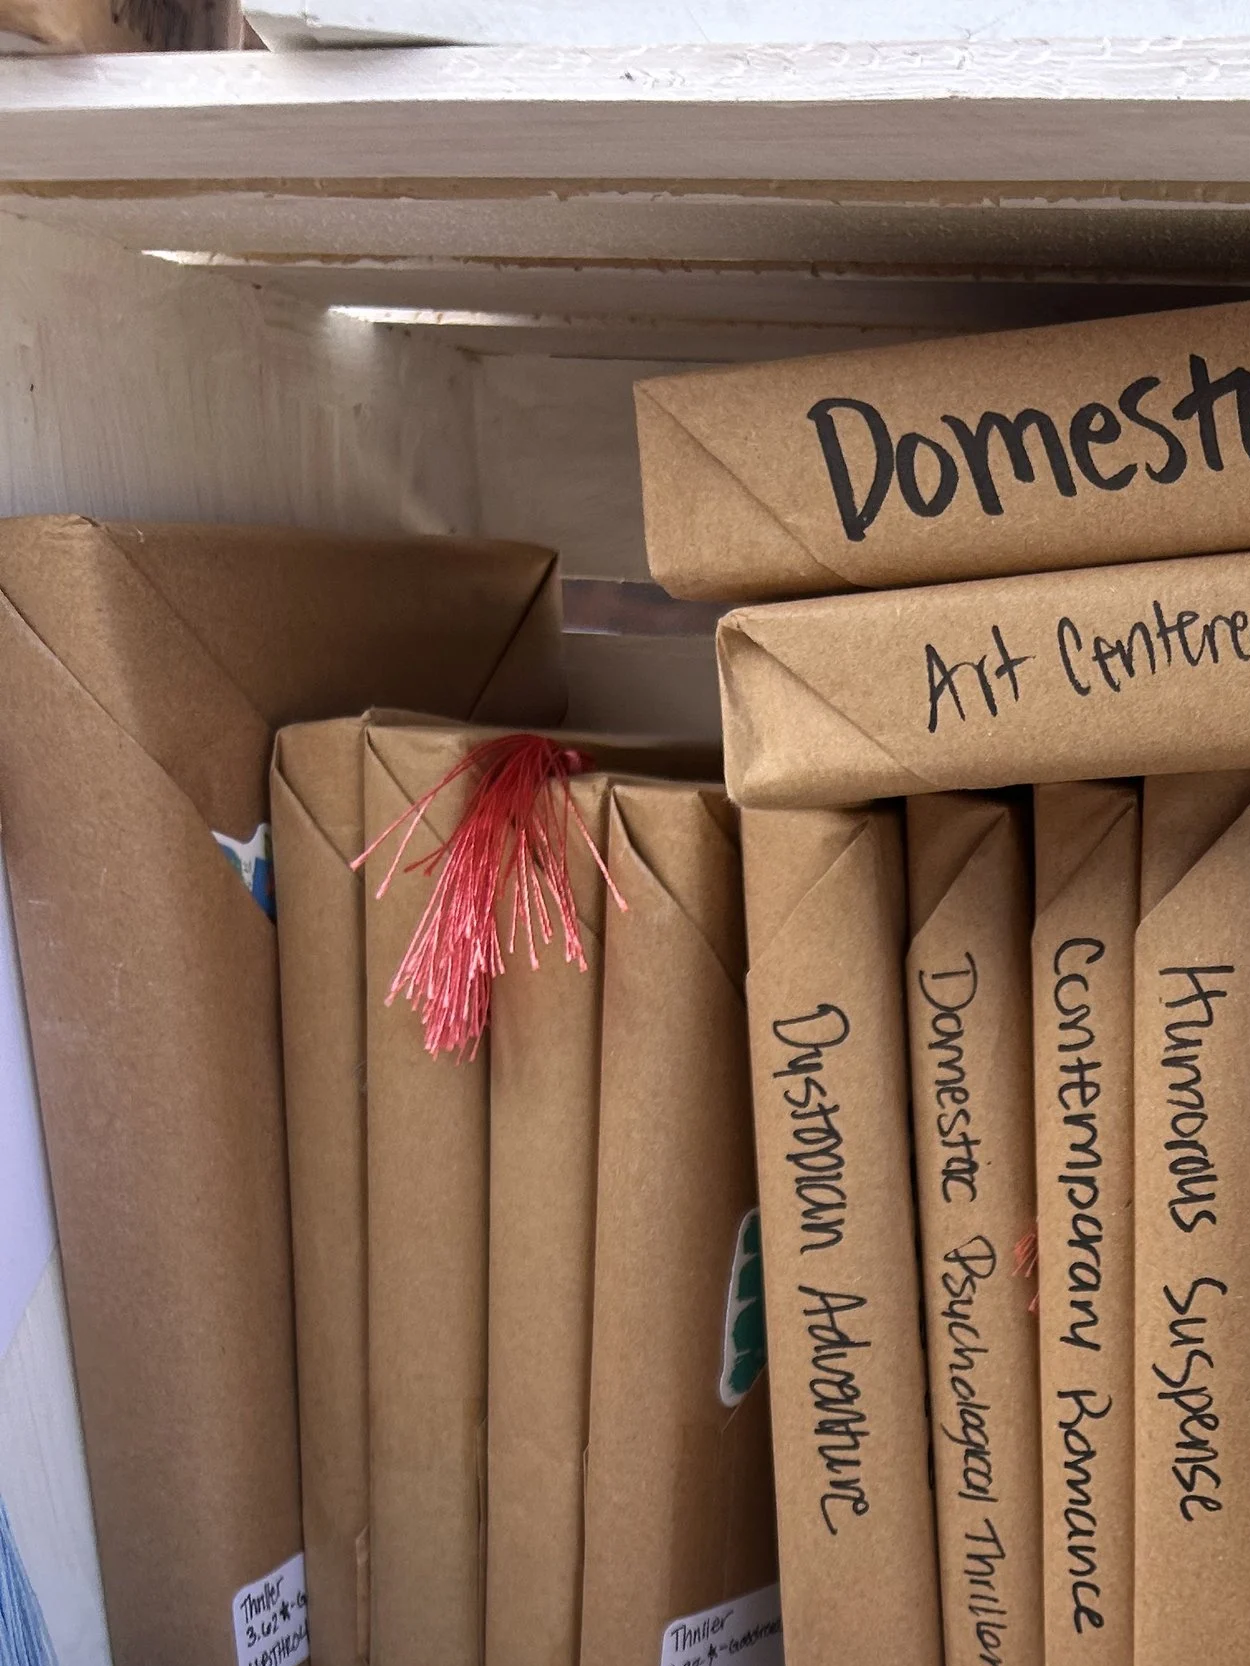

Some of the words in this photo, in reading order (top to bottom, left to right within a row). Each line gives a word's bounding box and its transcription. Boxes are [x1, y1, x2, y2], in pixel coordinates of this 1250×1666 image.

[924, 624, 1036, 734] Art
[772, 1003, 851, 1255] Dystopian
[918, 951, 981, 1203] Domestic
[1053, 937, 1106, 1352] Contemporary
[1158, 965, 1235, 1234] Humorous
[797, 1285, 872, 1536] Adventure
[941, 1234, 999, 1503] Psychological
[1152, 1277, 1228, 1522] Suspense
[240, 1576, 284, 1624] Thriller
[671, 1609, 734, 1653] Thriller
[1057, 1388, 1113, 1635] Romance
